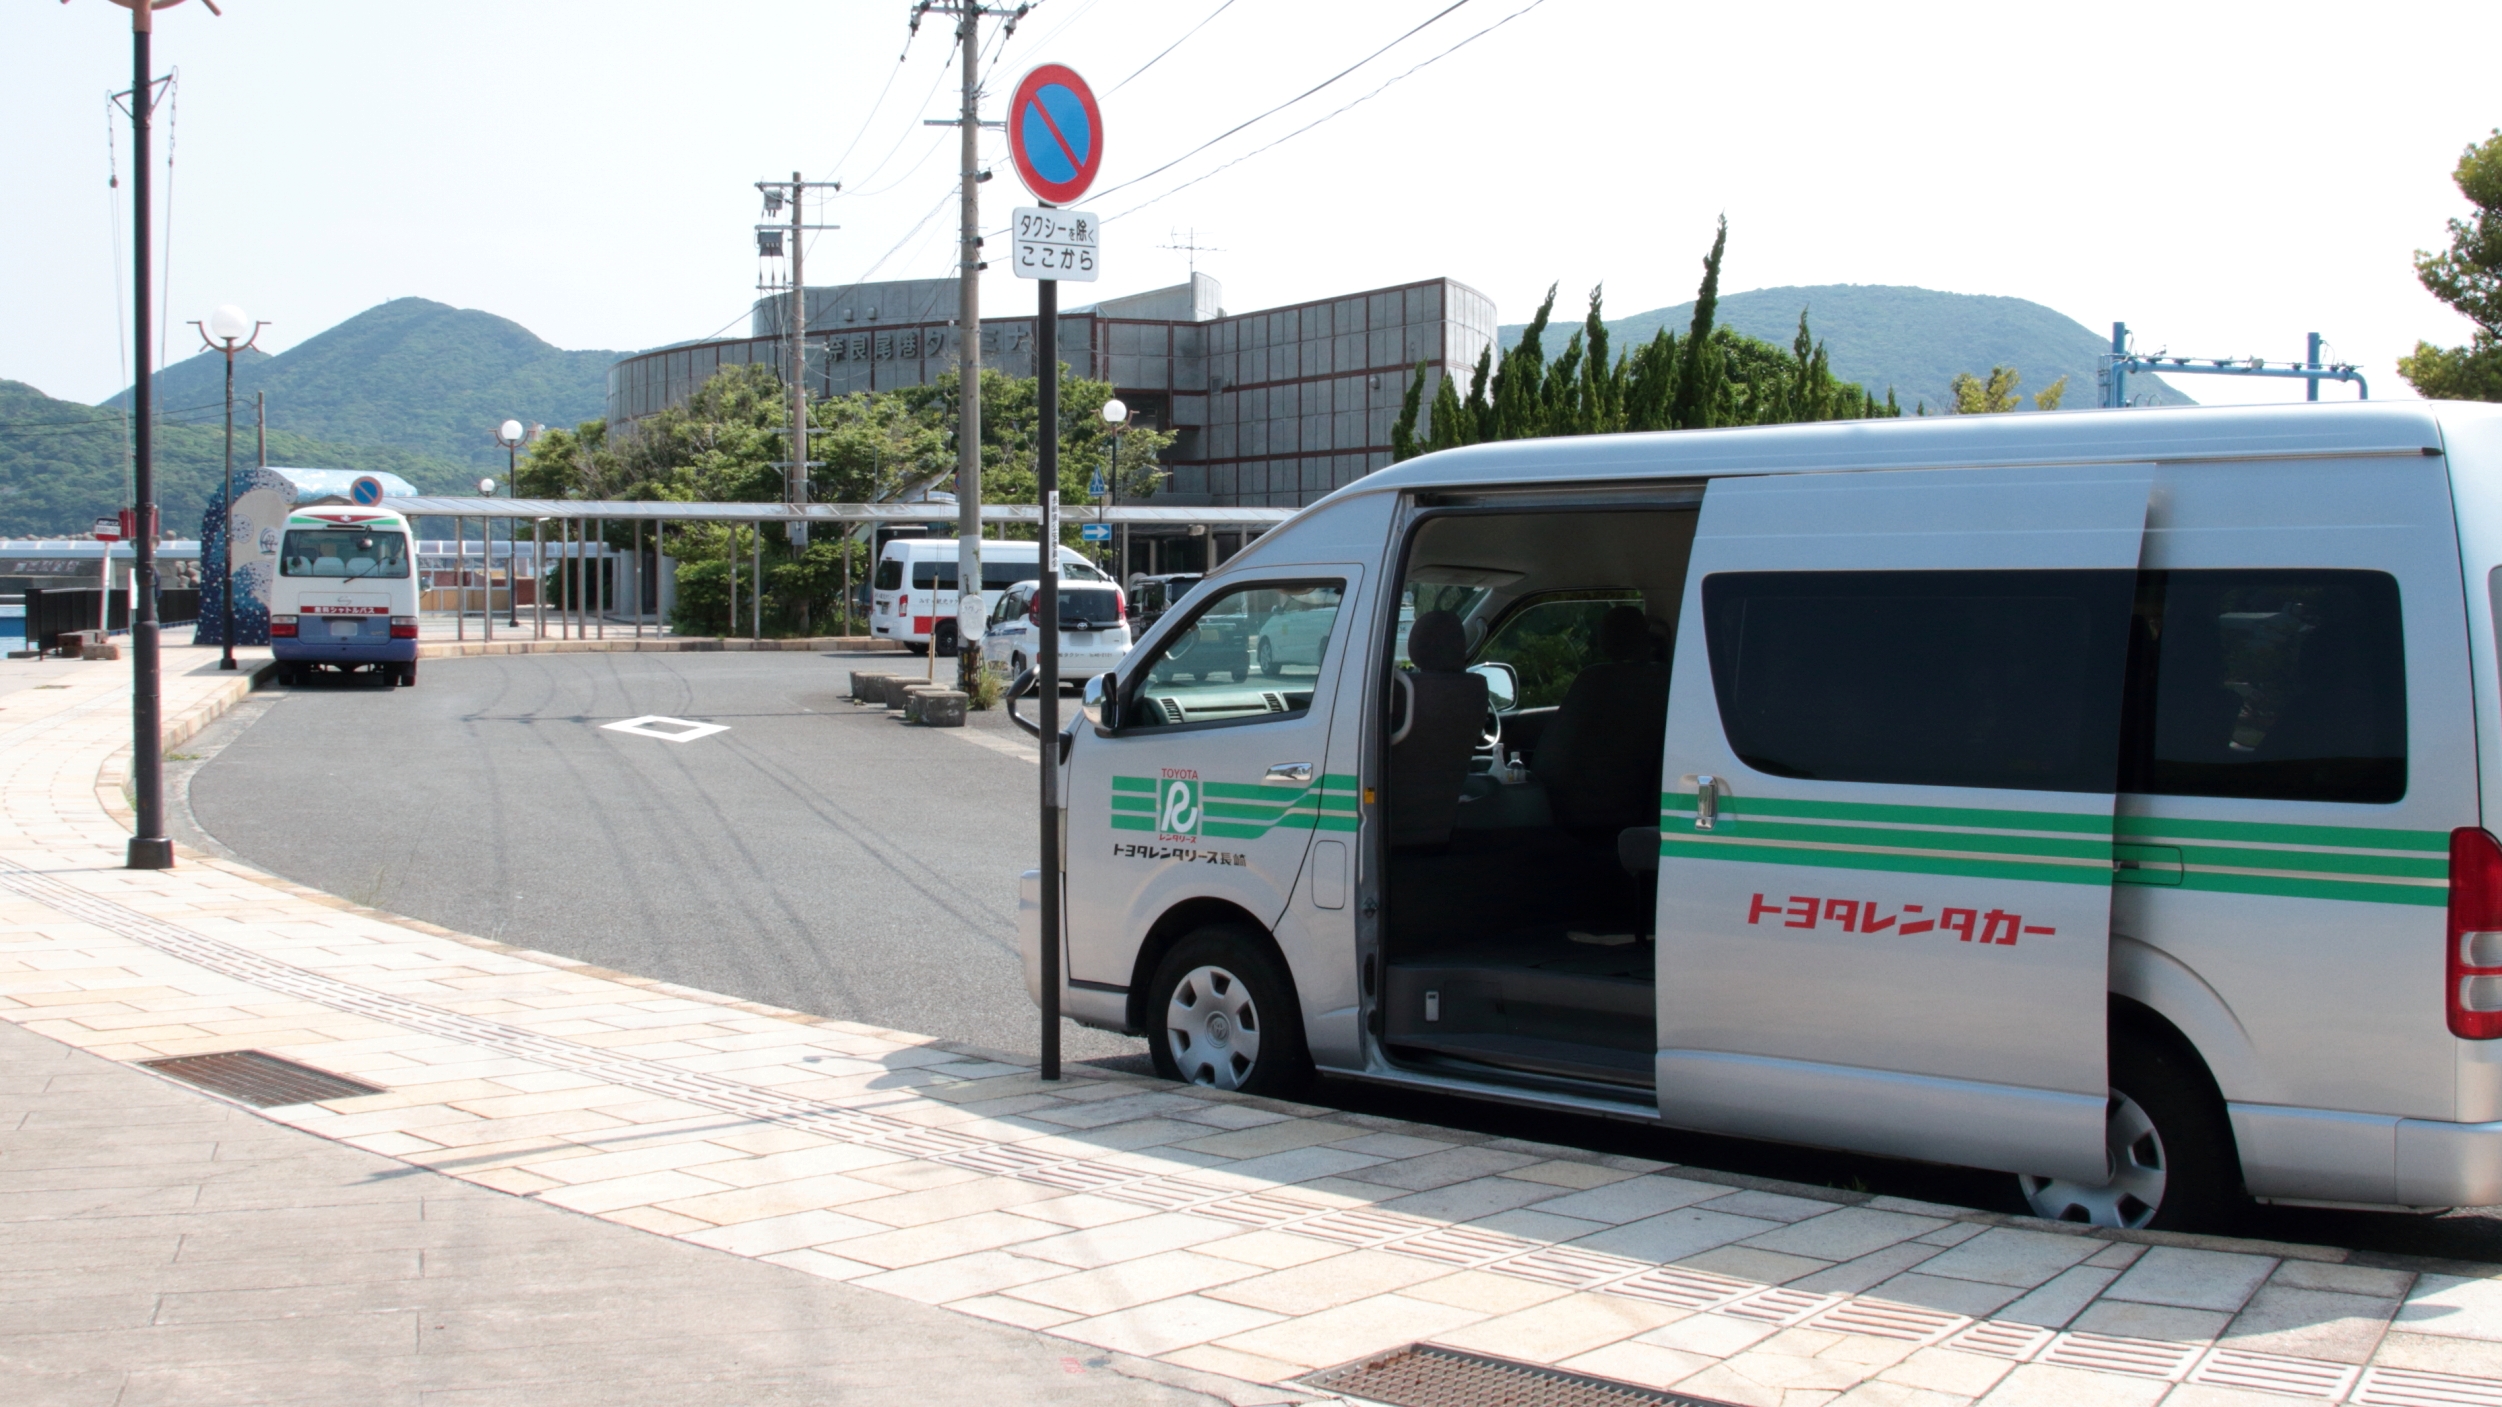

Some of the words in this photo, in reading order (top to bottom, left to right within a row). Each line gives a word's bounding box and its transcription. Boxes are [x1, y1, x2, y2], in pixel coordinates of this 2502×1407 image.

[1020, 214, 1094, 243] タクシーを除く
[1021, 245, 1094, 271] ここから
[826, 325, 1063, 362] 奈良尾港タミナ
[1161, 768, 1199, 780] TOYOTA
[1158, 833, 1197, 844] レンタリース
[1113, 843, 1247, 868] トヨタレンタリース長崎
[1748, 893, 2057, 946] トヨタレンタカー
